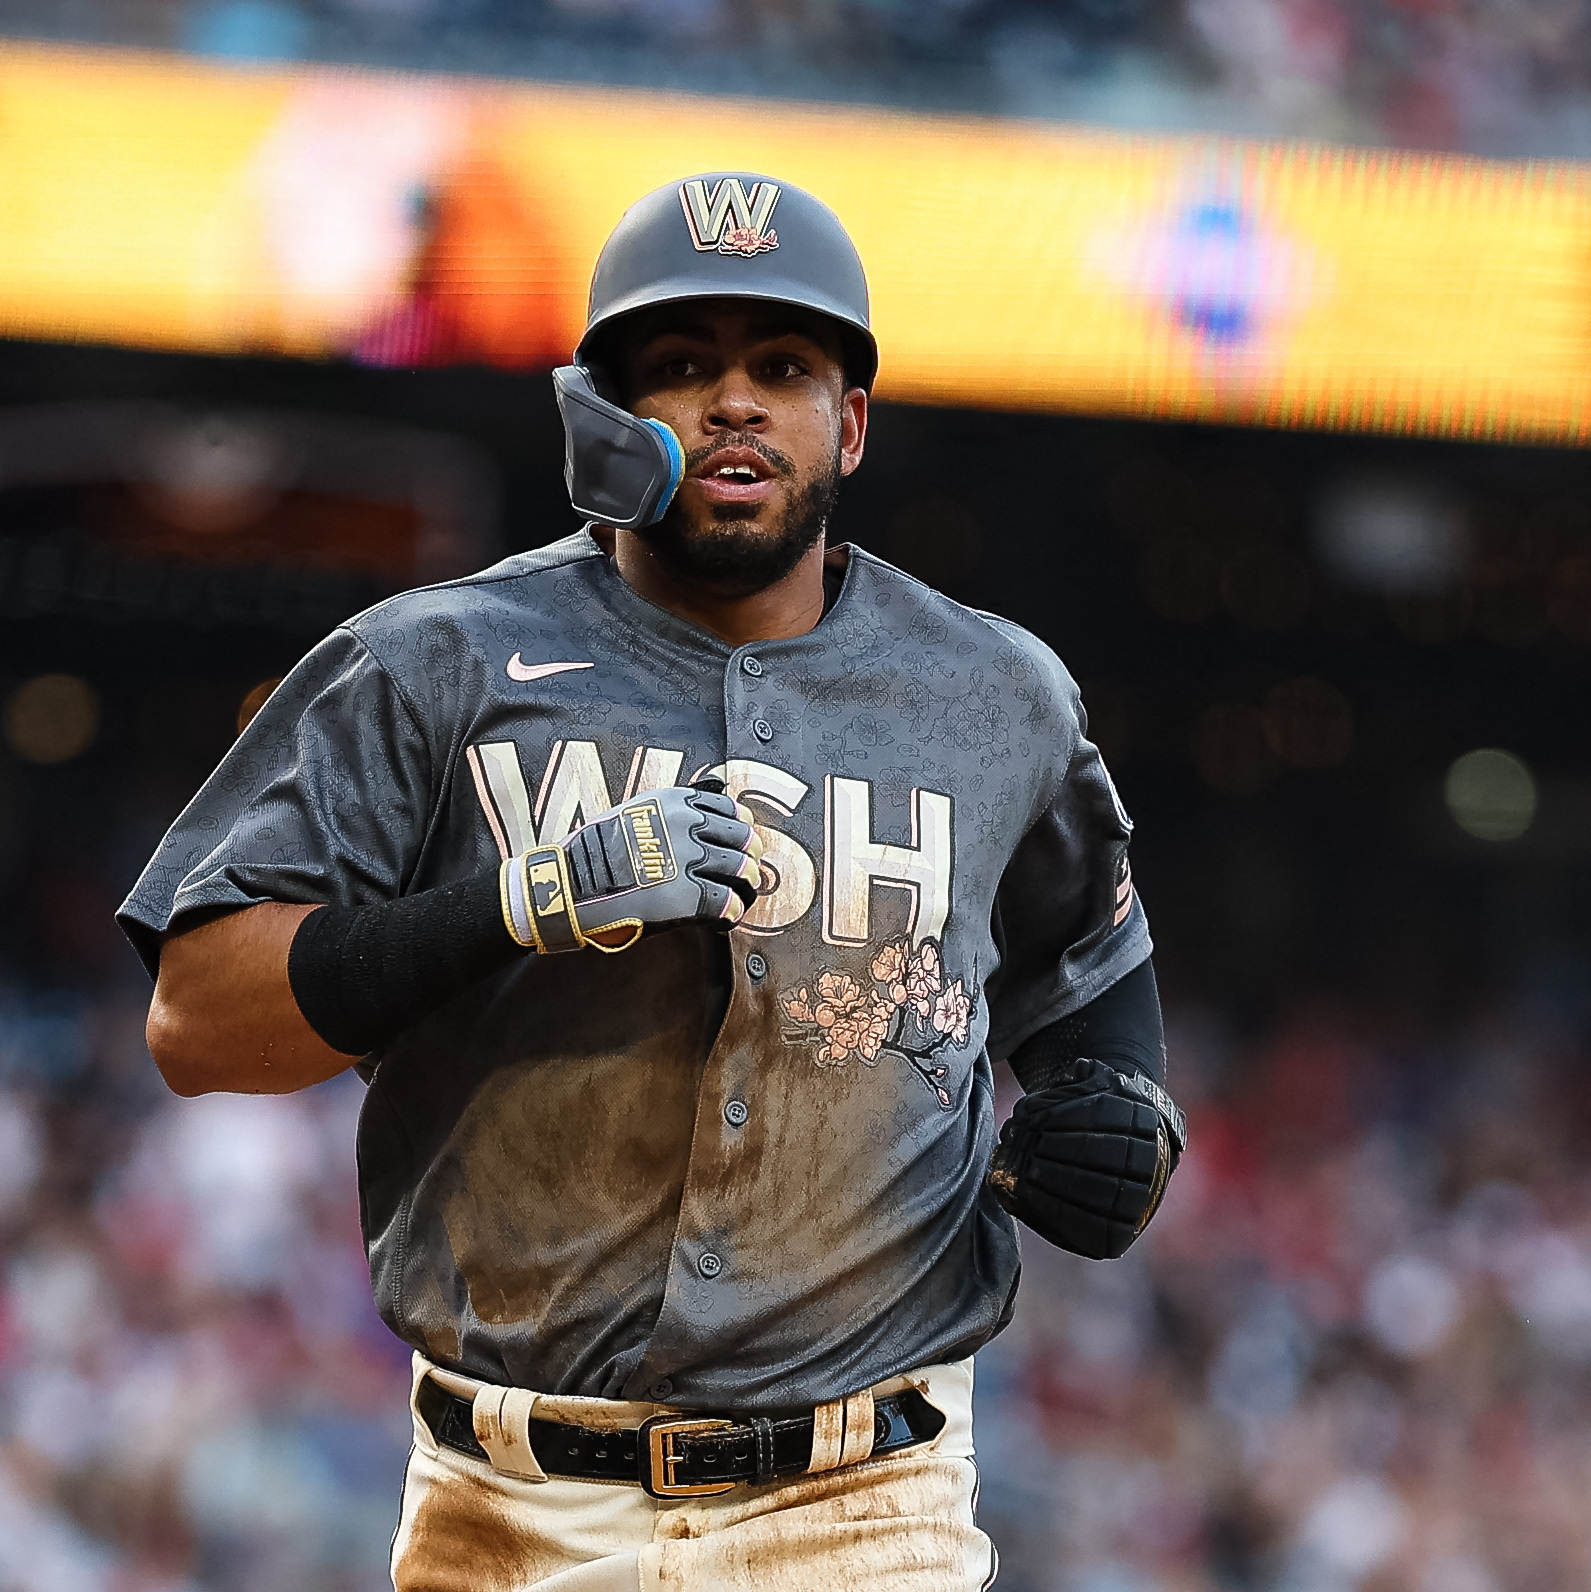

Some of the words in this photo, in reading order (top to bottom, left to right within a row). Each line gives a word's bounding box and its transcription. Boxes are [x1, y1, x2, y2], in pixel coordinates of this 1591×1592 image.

[678, 178, 782, 252] W
[466, 738, 956, 948] WSH
[622, 802, 668, 881] Franklin
